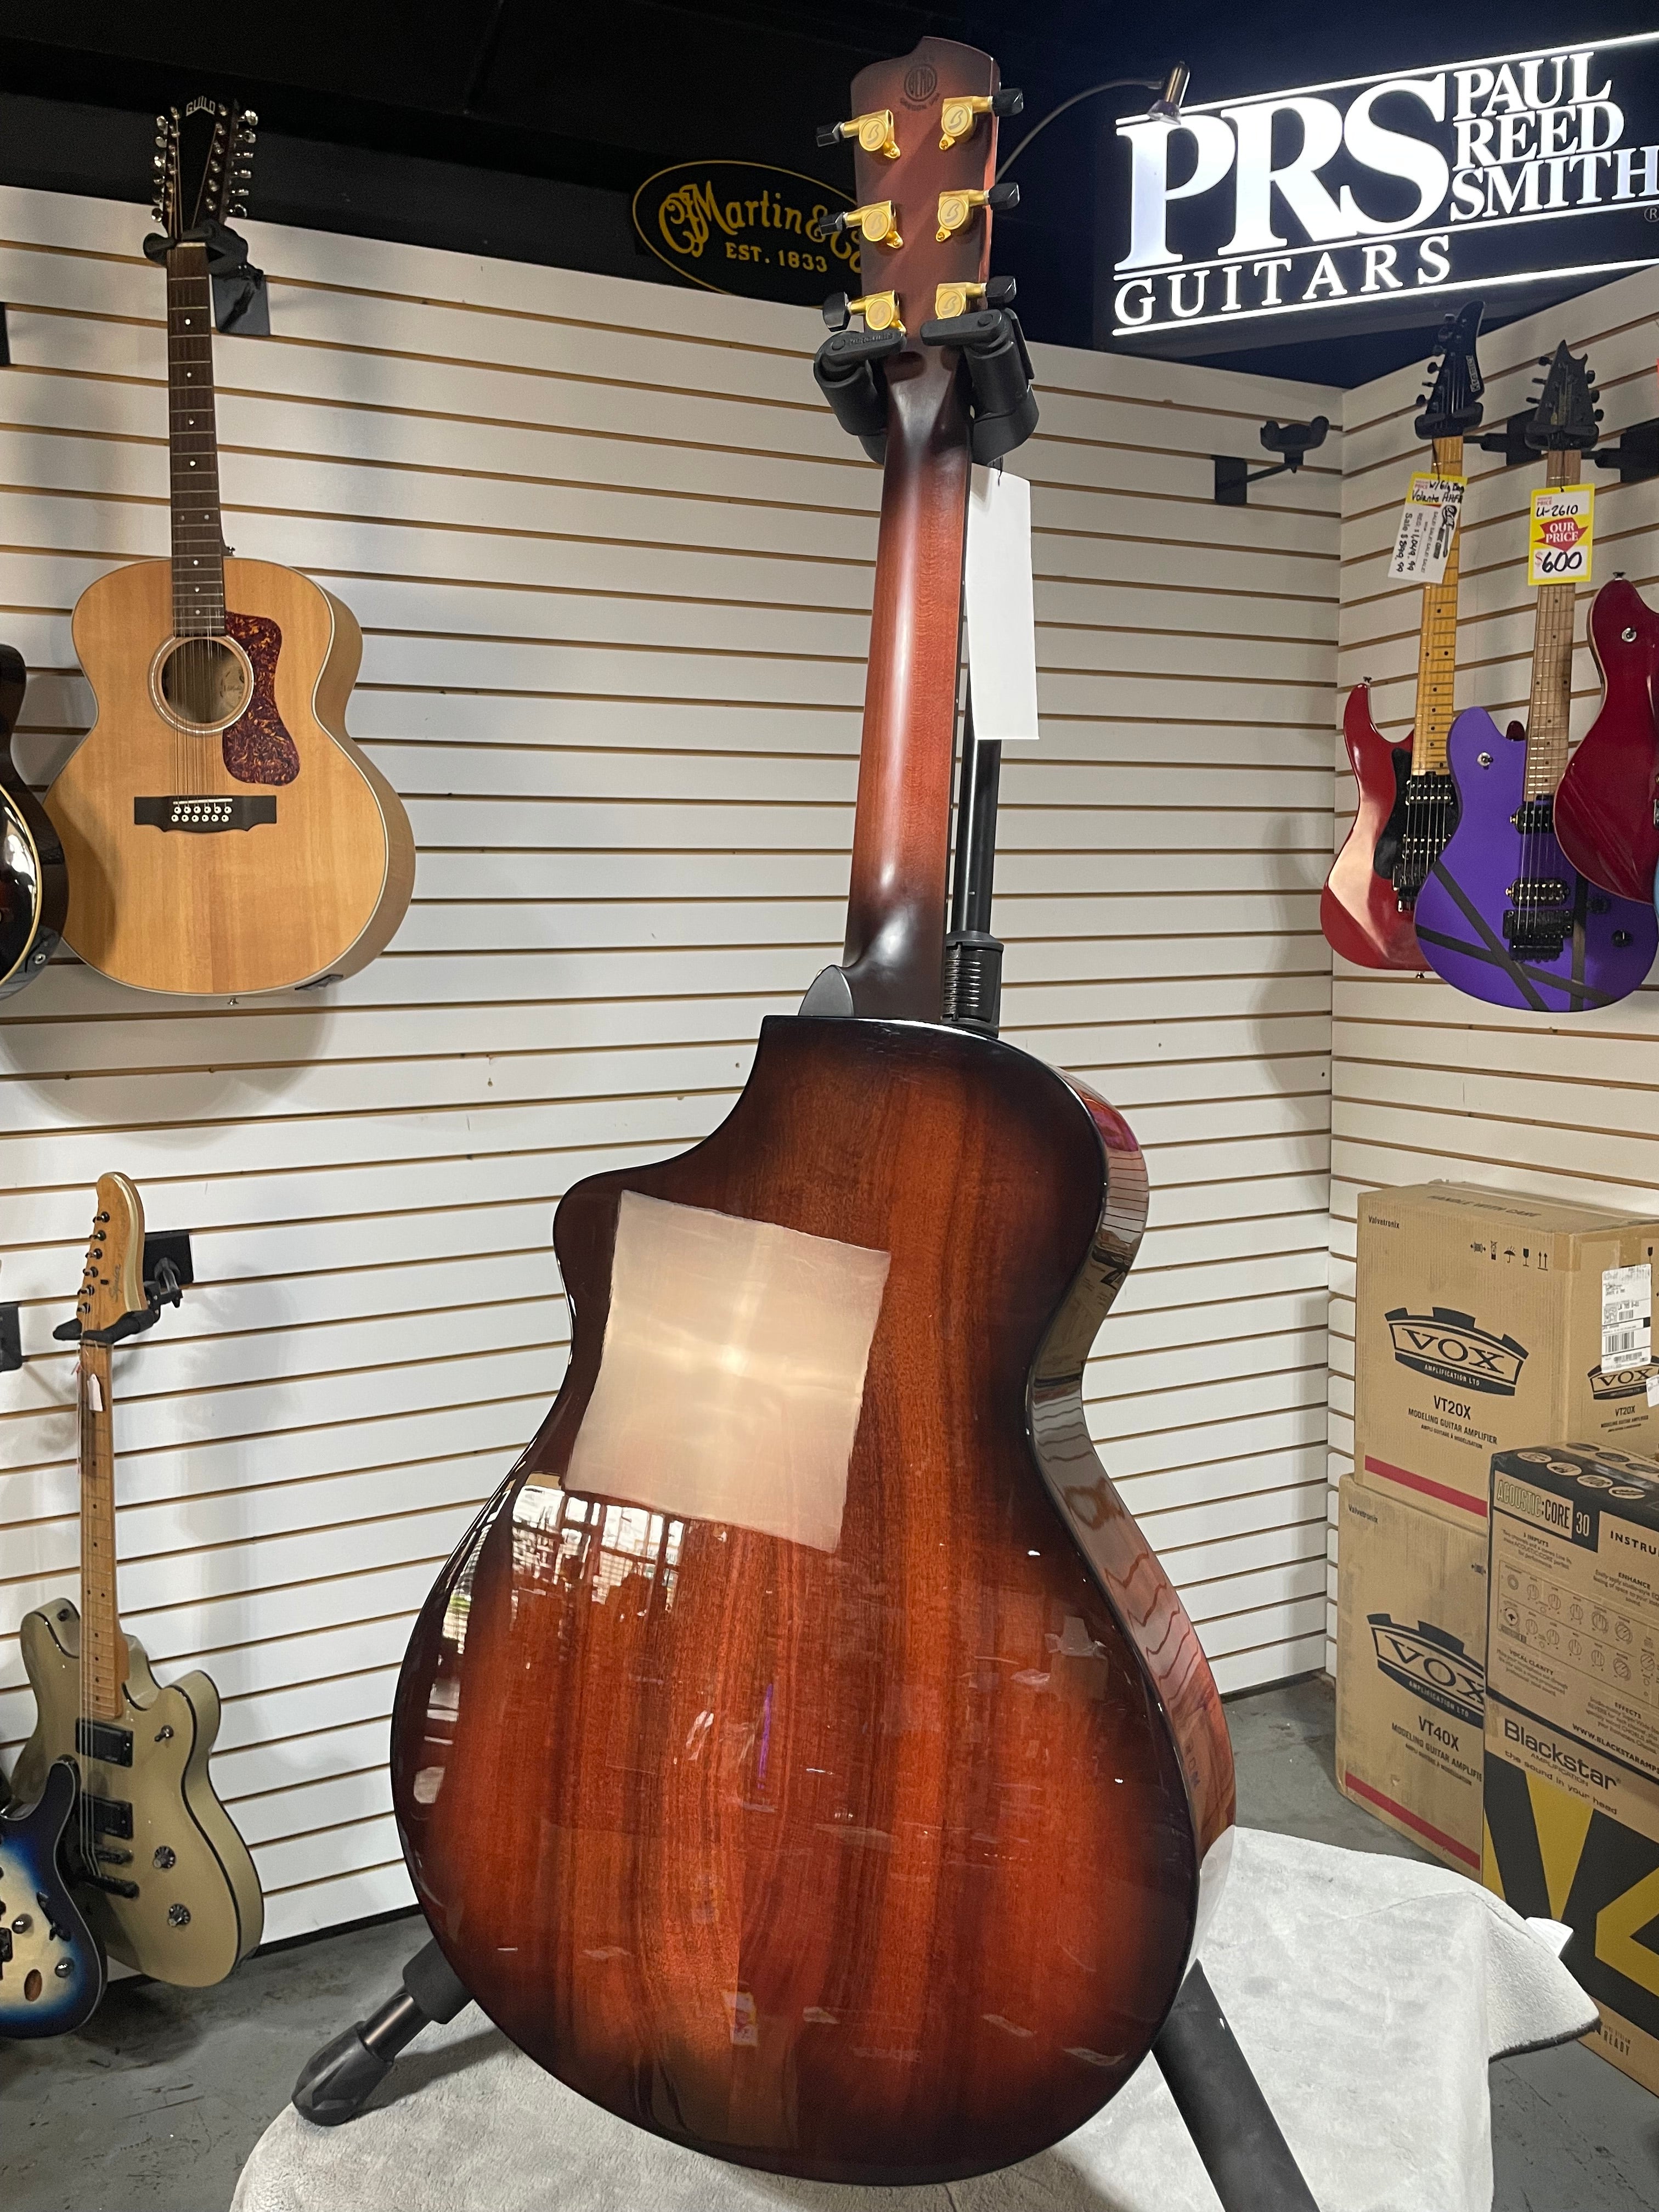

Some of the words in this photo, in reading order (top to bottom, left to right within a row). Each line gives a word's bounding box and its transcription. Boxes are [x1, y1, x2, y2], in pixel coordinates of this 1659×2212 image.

[1453, 52, 1612, 120] PAUL
[186, 95, 216, 117] GUILD
[1452, 100, 1624, 171] REED
[1115, 73, 1450, 271] PRS
[1449, 145, 1659, 221] SMITH
[690, 180, 803, 235] Martin
[725, 242, 770, 263] EST.
[778, 250, 828, 273] 1833
[1114, 234, 1451, 326] GUITARS
[1402, 512, 1413, 532] Sale
[1536, 504, 1578, 517] U-2610
[1545, 531, 1579, 543] PRICE
[1549, 521, 1575, 533] OUR
[1368, 1215, 1400, 1230] Valvetronix
[1402, 1327, 1505, 1375] VOX
[1424, 1364, 1467, 1383] AMPLIFICATION
[1468, 1376, 1480, 1386] LTD
[1597, 1367, 1654, 1386] VOX
[1433, 1395, 1471, 1420] VT20X
[1615, 1405, 1635, 1417] VT20X
[1407, 1407, 1439, 1425] MODELING
[1440, 1418, 1463, 1433] GUITAR
[1463, 1426, 1498, 1445] AMPLIFIER
[1576, 1511, 1590, 1537] 30
[1610, 1530, 1659, 1558] INSTRU
[1385, 1634, 1484, 1705] VOX
[1457, 1706, 1469, 1718] LTD
[1418, 1716, 1459, 1752] VT40X
[1425, 1742, 1449, 1763] GUITAR
[1451, 1758, 1482, 1782] AMPLIFIE
[1504, 1718, 1617, 1791] Blackstar
[1531, 1752, 1588, 1787] AMPLIFICATION
[1505, 1750, 1521, 1764] the
[1524, 1761, 1553, 1780] sound
[1556, 1776, 1565, 1787] in
[1567, 1784, 1590, 1799] your
[1593, 1796, 1617, 1815] head
[1604, 2030, 1630, 2056] READY
